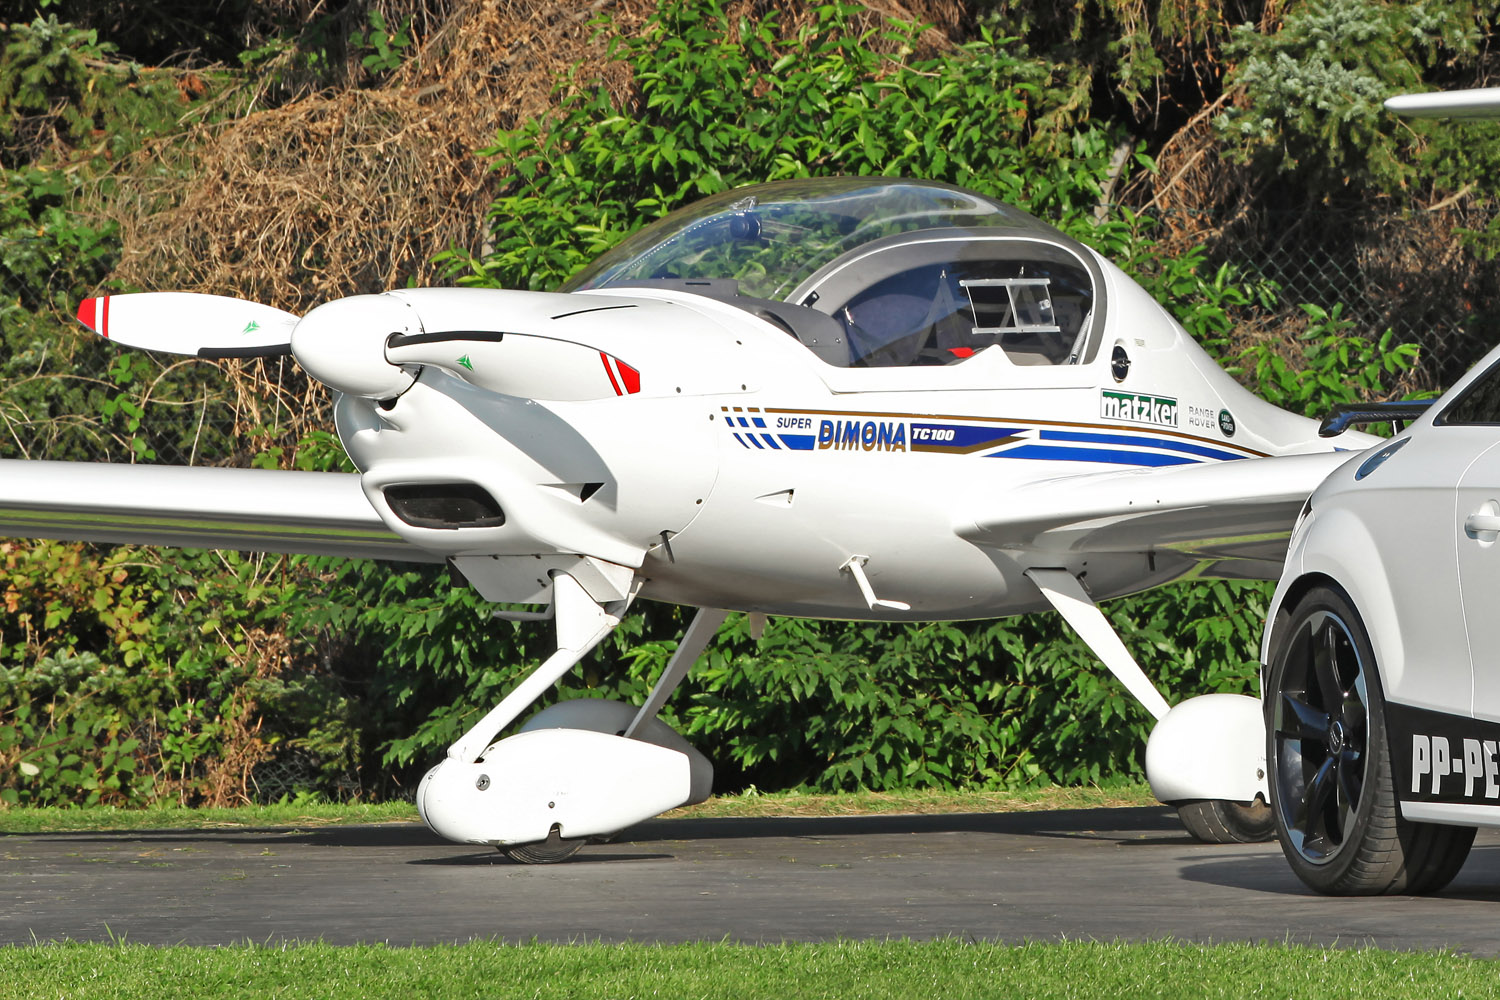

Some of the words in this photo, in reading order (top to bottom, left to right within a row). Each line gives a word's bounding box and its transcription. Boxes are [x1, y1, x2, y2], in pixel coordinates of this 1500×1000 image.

[1102, 395, 1177, 426] matzker
[1188, 405, 1214, 419] RANGE
[776, 417, 812, 429] SUPER
[818, 419, 906, 452] DIMONA
[912, 427, 955, 441] TC100
[1188, 418, 1216, 430] ROVER
